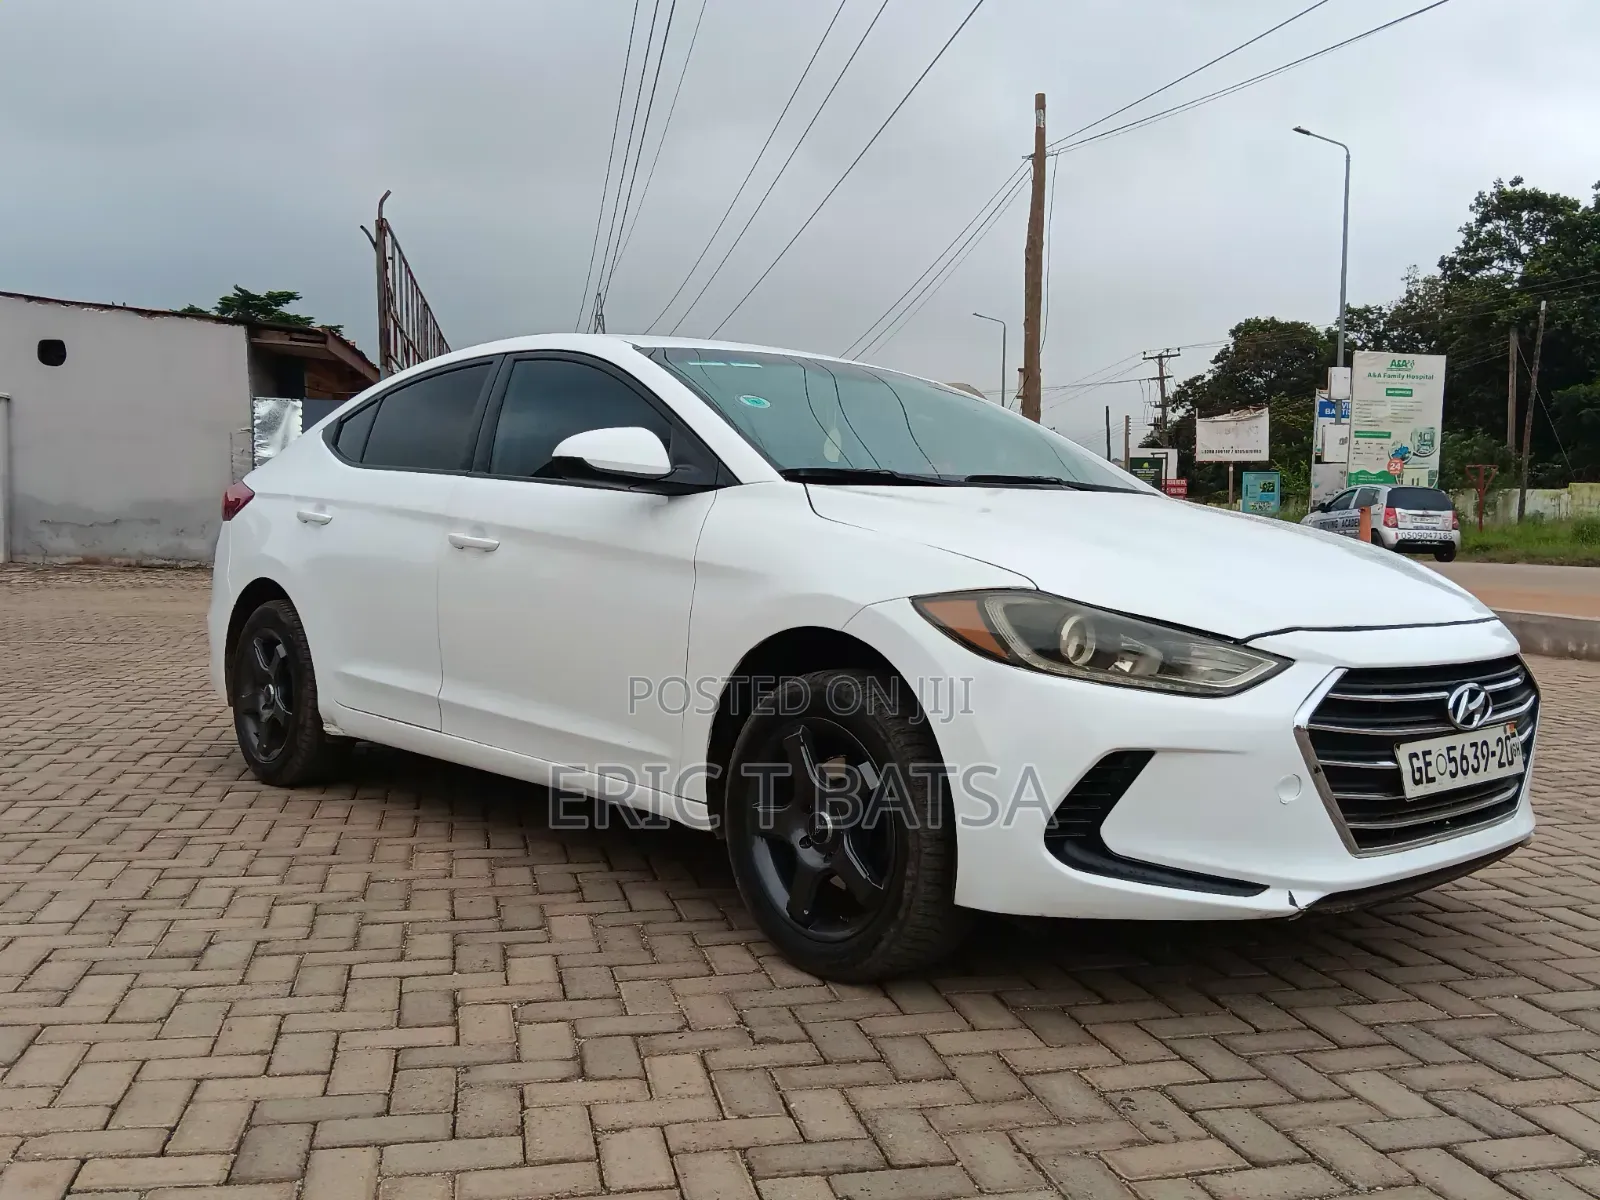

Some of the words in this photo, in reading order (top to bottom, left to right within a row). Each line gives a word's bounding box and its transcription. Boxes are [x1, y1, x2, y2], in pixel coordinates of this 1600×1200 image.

[1390, 359, 1408, 367] A&A
[1325, 408, 1351, 416] BATI
[1408, 748, 1436, 786] GE
[1446, 734, 1514, 779] 5639-20
